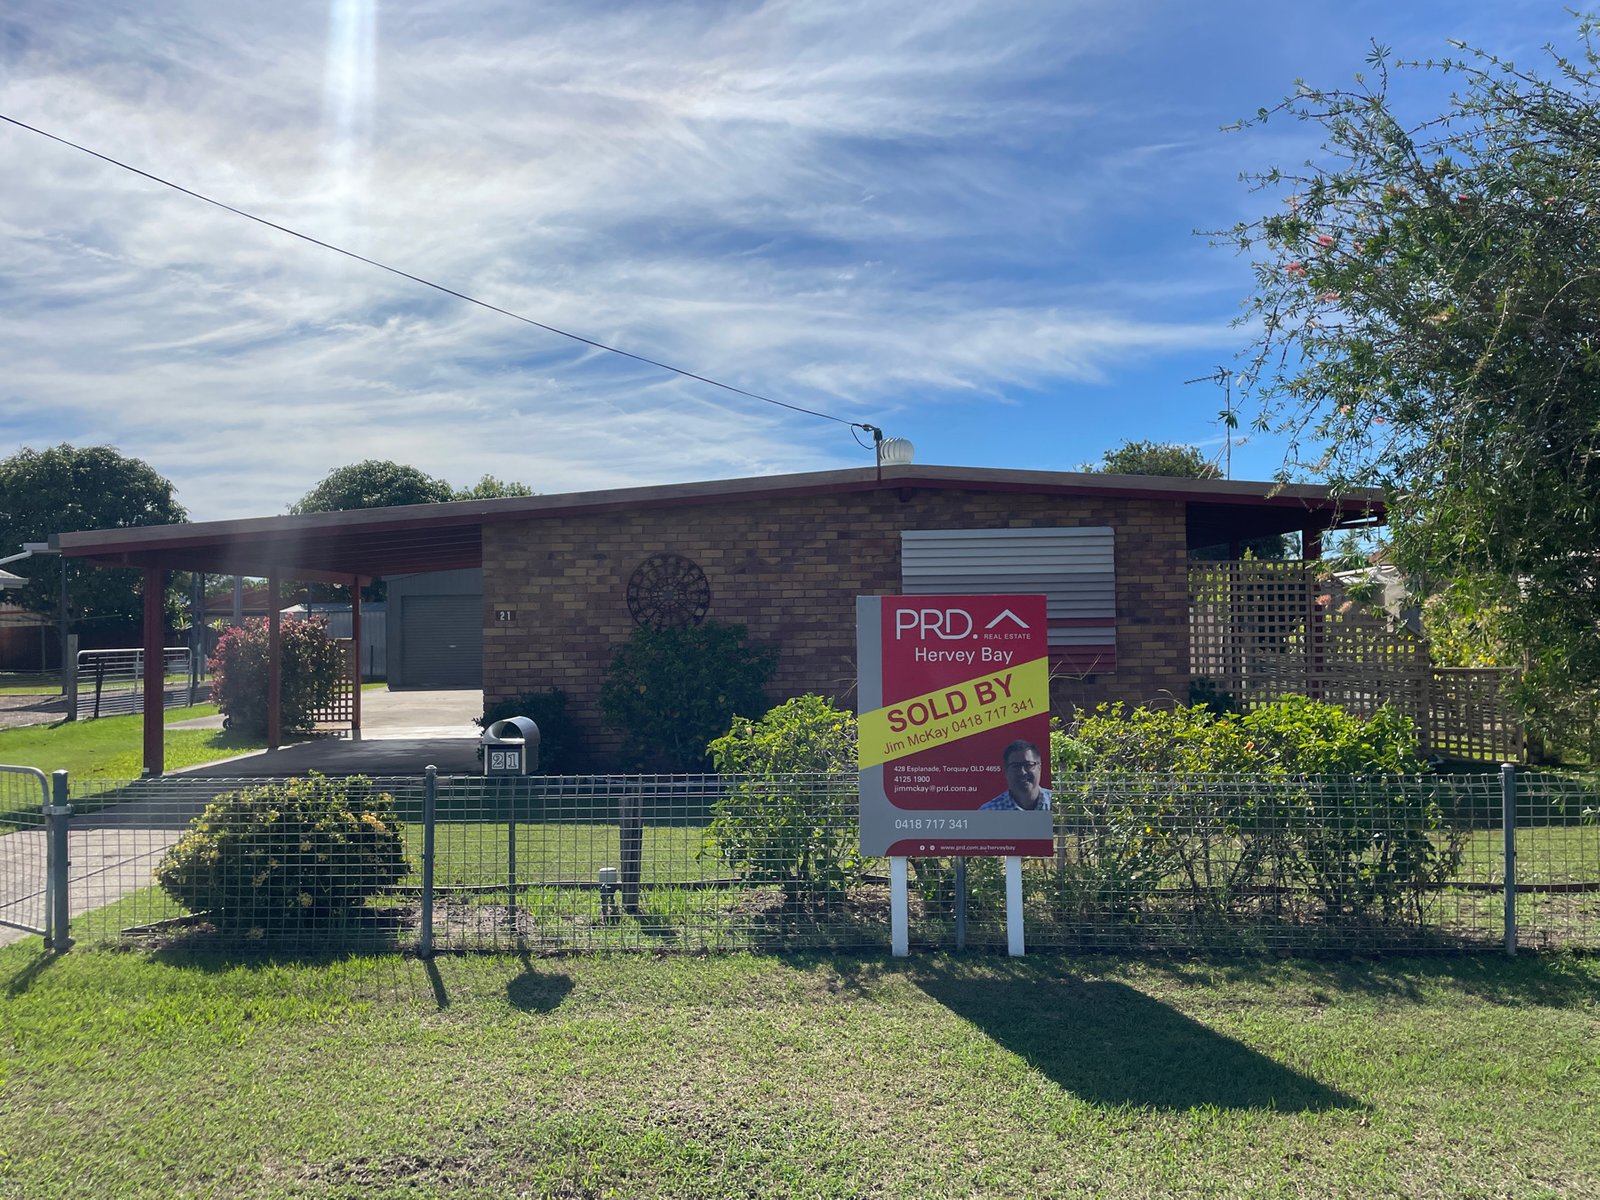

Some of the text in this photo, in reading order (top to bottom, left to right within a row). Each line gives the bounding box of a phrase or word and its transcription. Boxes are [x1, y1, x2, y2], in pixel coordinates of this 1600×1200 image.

[500, 611, 511, 620] 21
[896, 608, 978, 640] PRD.
[915, 647, 1013, 665] Hervey Bay
[887, 673, 1012, 733] SOLD BY
[884, 698, 1034, 754] Jim McKay 0418 717 341
[492, 753, 517, 768] 21
[894, 785, 978, 793] jimmckay@prd.com.au
[895, 820, 968, 829] 0418 717 341
